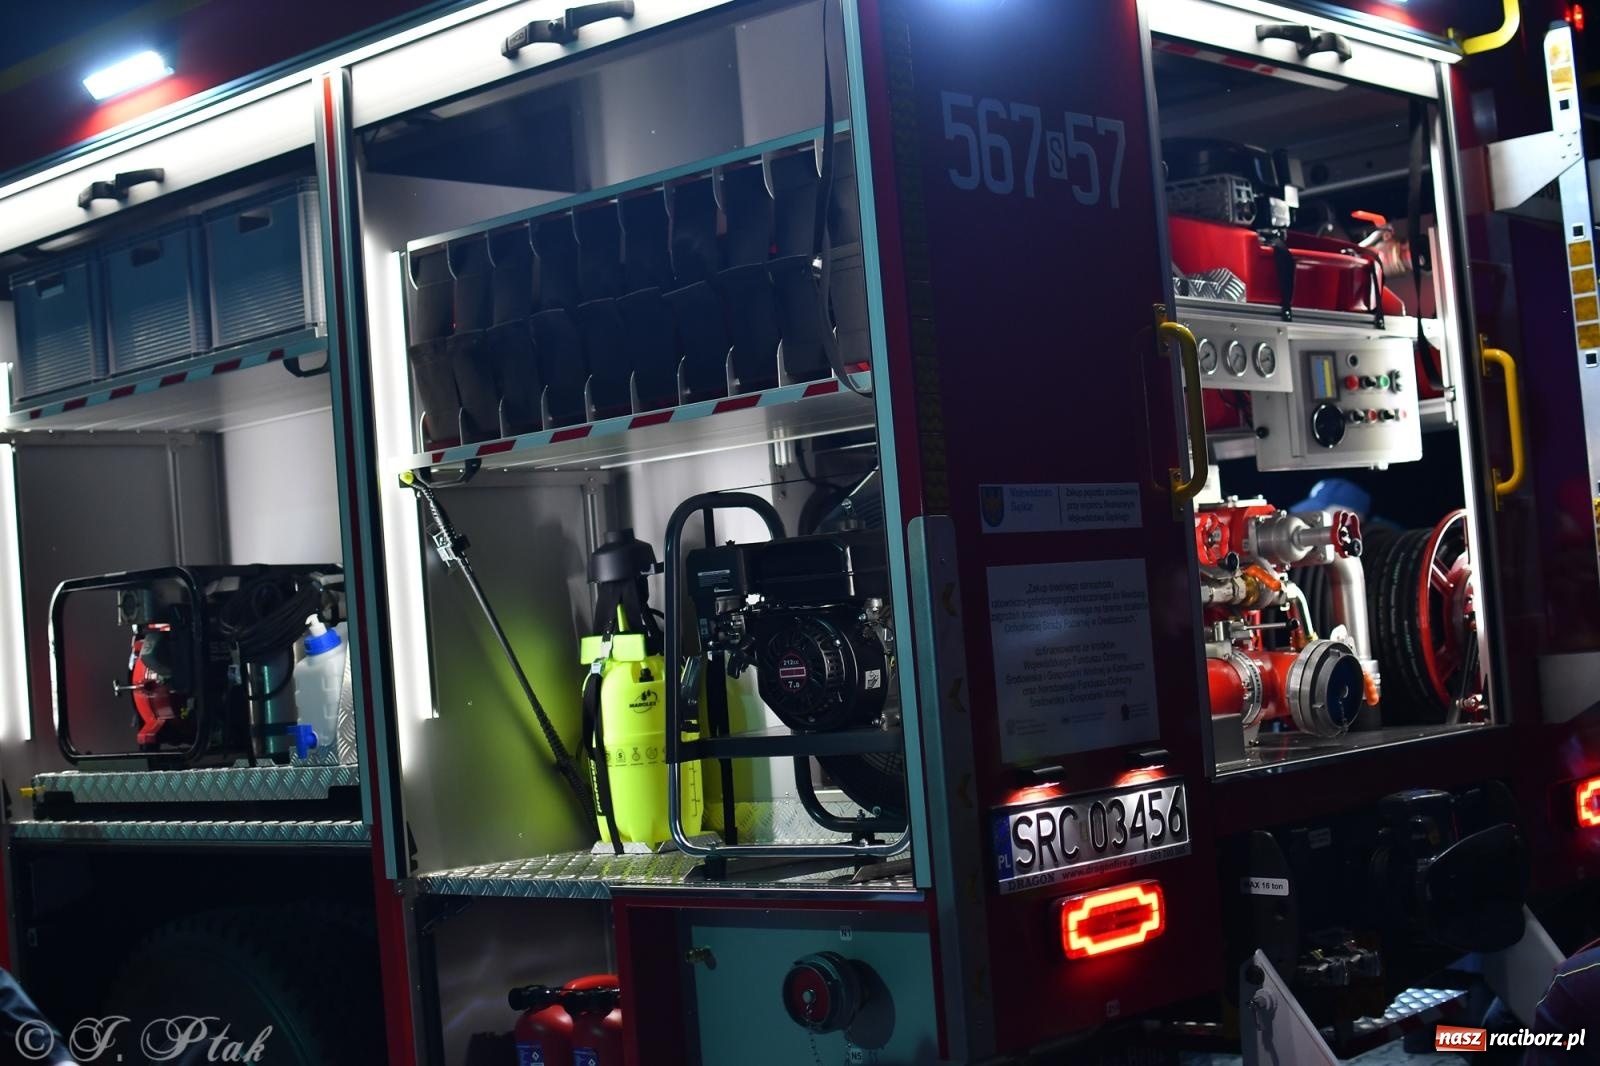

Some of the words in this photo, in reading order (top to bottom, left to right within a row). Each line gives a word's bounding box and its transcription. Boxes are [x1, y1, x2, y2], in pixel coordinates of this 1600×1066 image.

[941, 90, 1042, 199] 567
[1064, 111, 1126, 210] 57
[1012, 806, 1079, 872] SRC
[1088, 785, 1185, 852] 03456
[998, 853, 1013, 871] PL
[1008, 871, 1056, 892] DRAGON
[1061, 856, 1138, 880] www.dragonfire.pl
[1271, 882, 1284, 890] ton
[841, 928, 851, 937] N1
